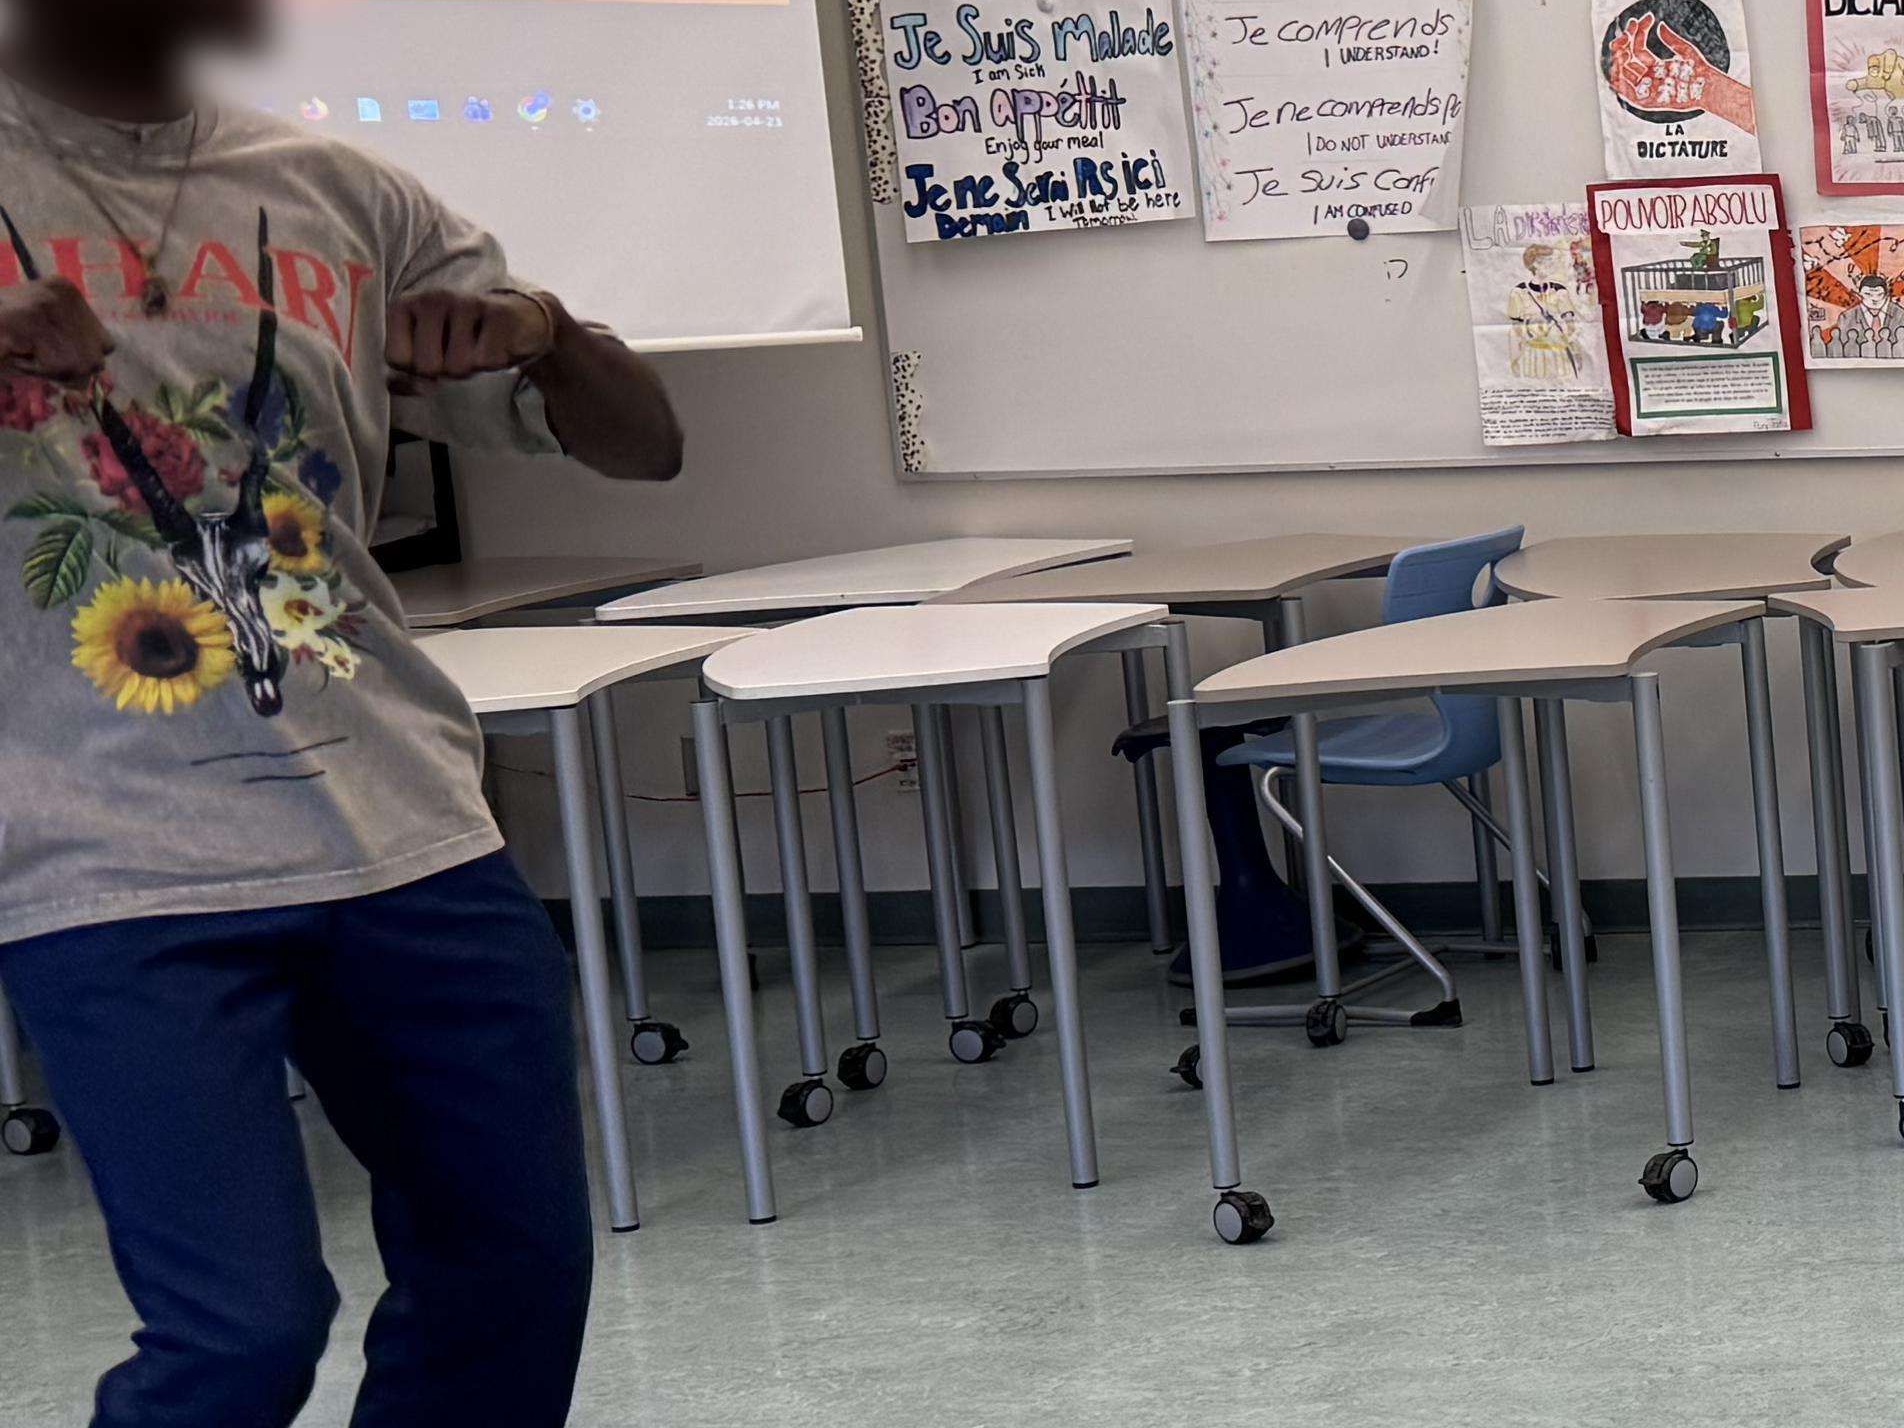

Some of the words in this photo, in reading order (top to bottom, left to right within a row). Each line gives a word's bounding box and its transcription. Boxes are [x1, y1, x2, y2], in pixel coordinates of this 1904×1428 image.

[890, 12, 952, 71] Je
[956, 3, 1042, 66] Suis
[1051, 7, 1174, 63] Malade
[1224, 15, 1269, 46] Je
[1324, 47, 1330, 68] I
[1340, 39, 1440, 66] UNDERSTAND!
[974, 68, 983, 85] I
[988, 68, 1011, 82] am
[900, 83, 983, 140] Bon
[1223, 96, 1271, 135] Je
[1276, 101, 1314, 125] ne
[1306, 132, 1311, 156] I
[1316, 132, 1337, 152] DO
[1341, 133, 1370, 152] NOT
[1664, 123, 1686, 137] LA
[985, 136, 1029, 165] Enjoy
[1033, 136, 1064, 164] your
[1067, 130, 1105, 150] meal
[1636, 139, 1729, 160] DICTATURE
[904, 163, 952, 219] Je
[953, 174, 999, 210] ne
[1002, 160, 1070, 209] Serai
[1121, 149, 1167, 196] ici
[1234, 166, 1289, 206] Je
[1048, 206, 1056, 222] I
[1116, 195, 1140, 213] be
[1145, 190, 1183, 209] here
[1313, 205, 1319, 225] I
[1324, 204, 1344, 220] AM
[1347, 200, 1413, 219] CONFUSED
[1600, 194, 1687, 231] POUVOIR
[1690, 191, 1768, 226] ABSOLU
[935, 208, 1031, 241] Demain
[1463, 202, 1512, 252] LA
